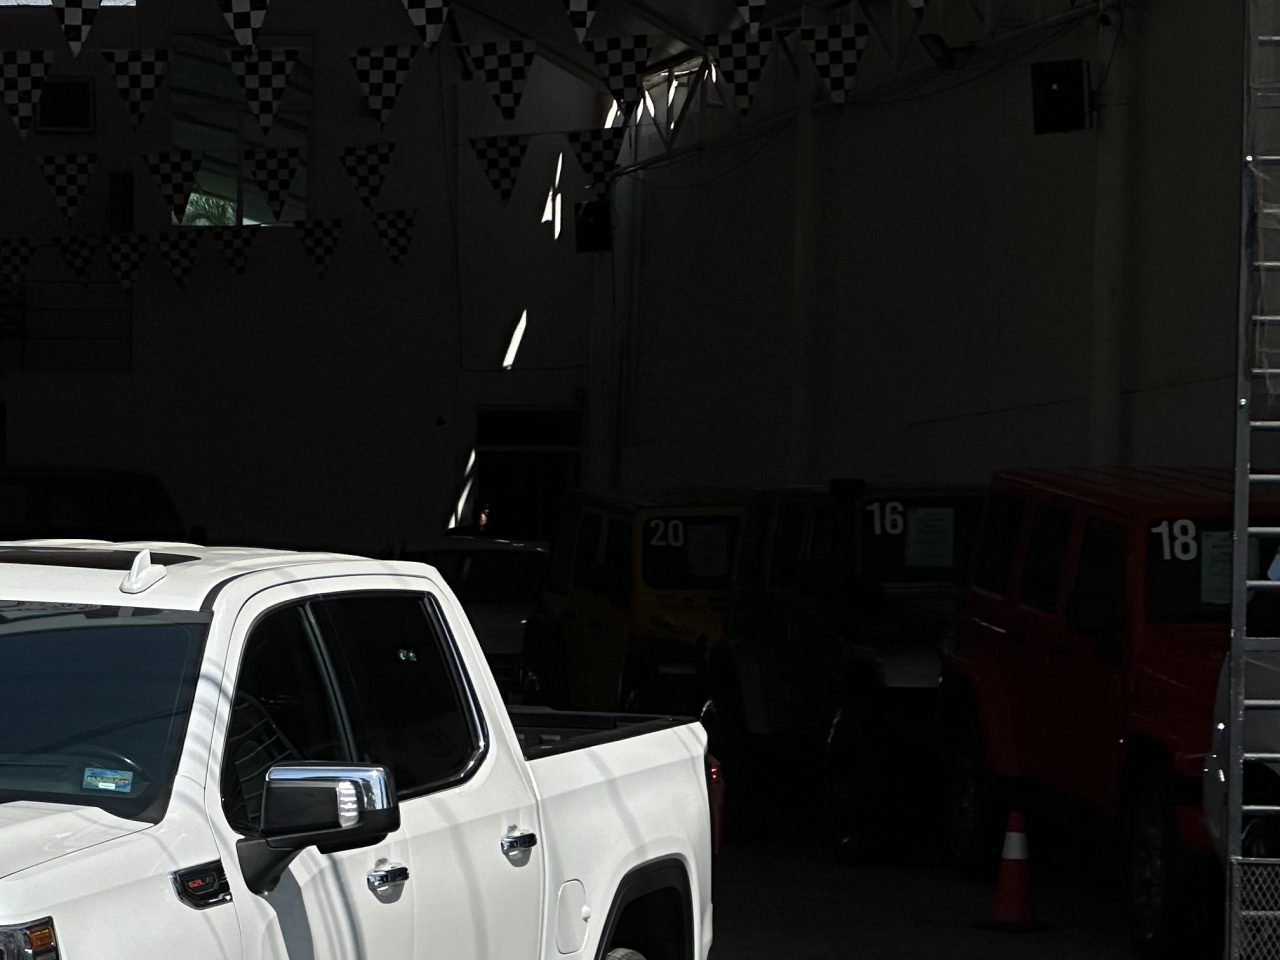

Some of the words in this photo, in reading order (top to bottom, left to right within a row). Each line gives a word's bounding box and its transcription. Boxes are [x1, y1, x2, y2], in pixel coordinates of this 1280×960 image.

[649, 519, 685, 547] 20
[864, 501, 905, 535] 16
[1149, 518, 1198, 561] 18
